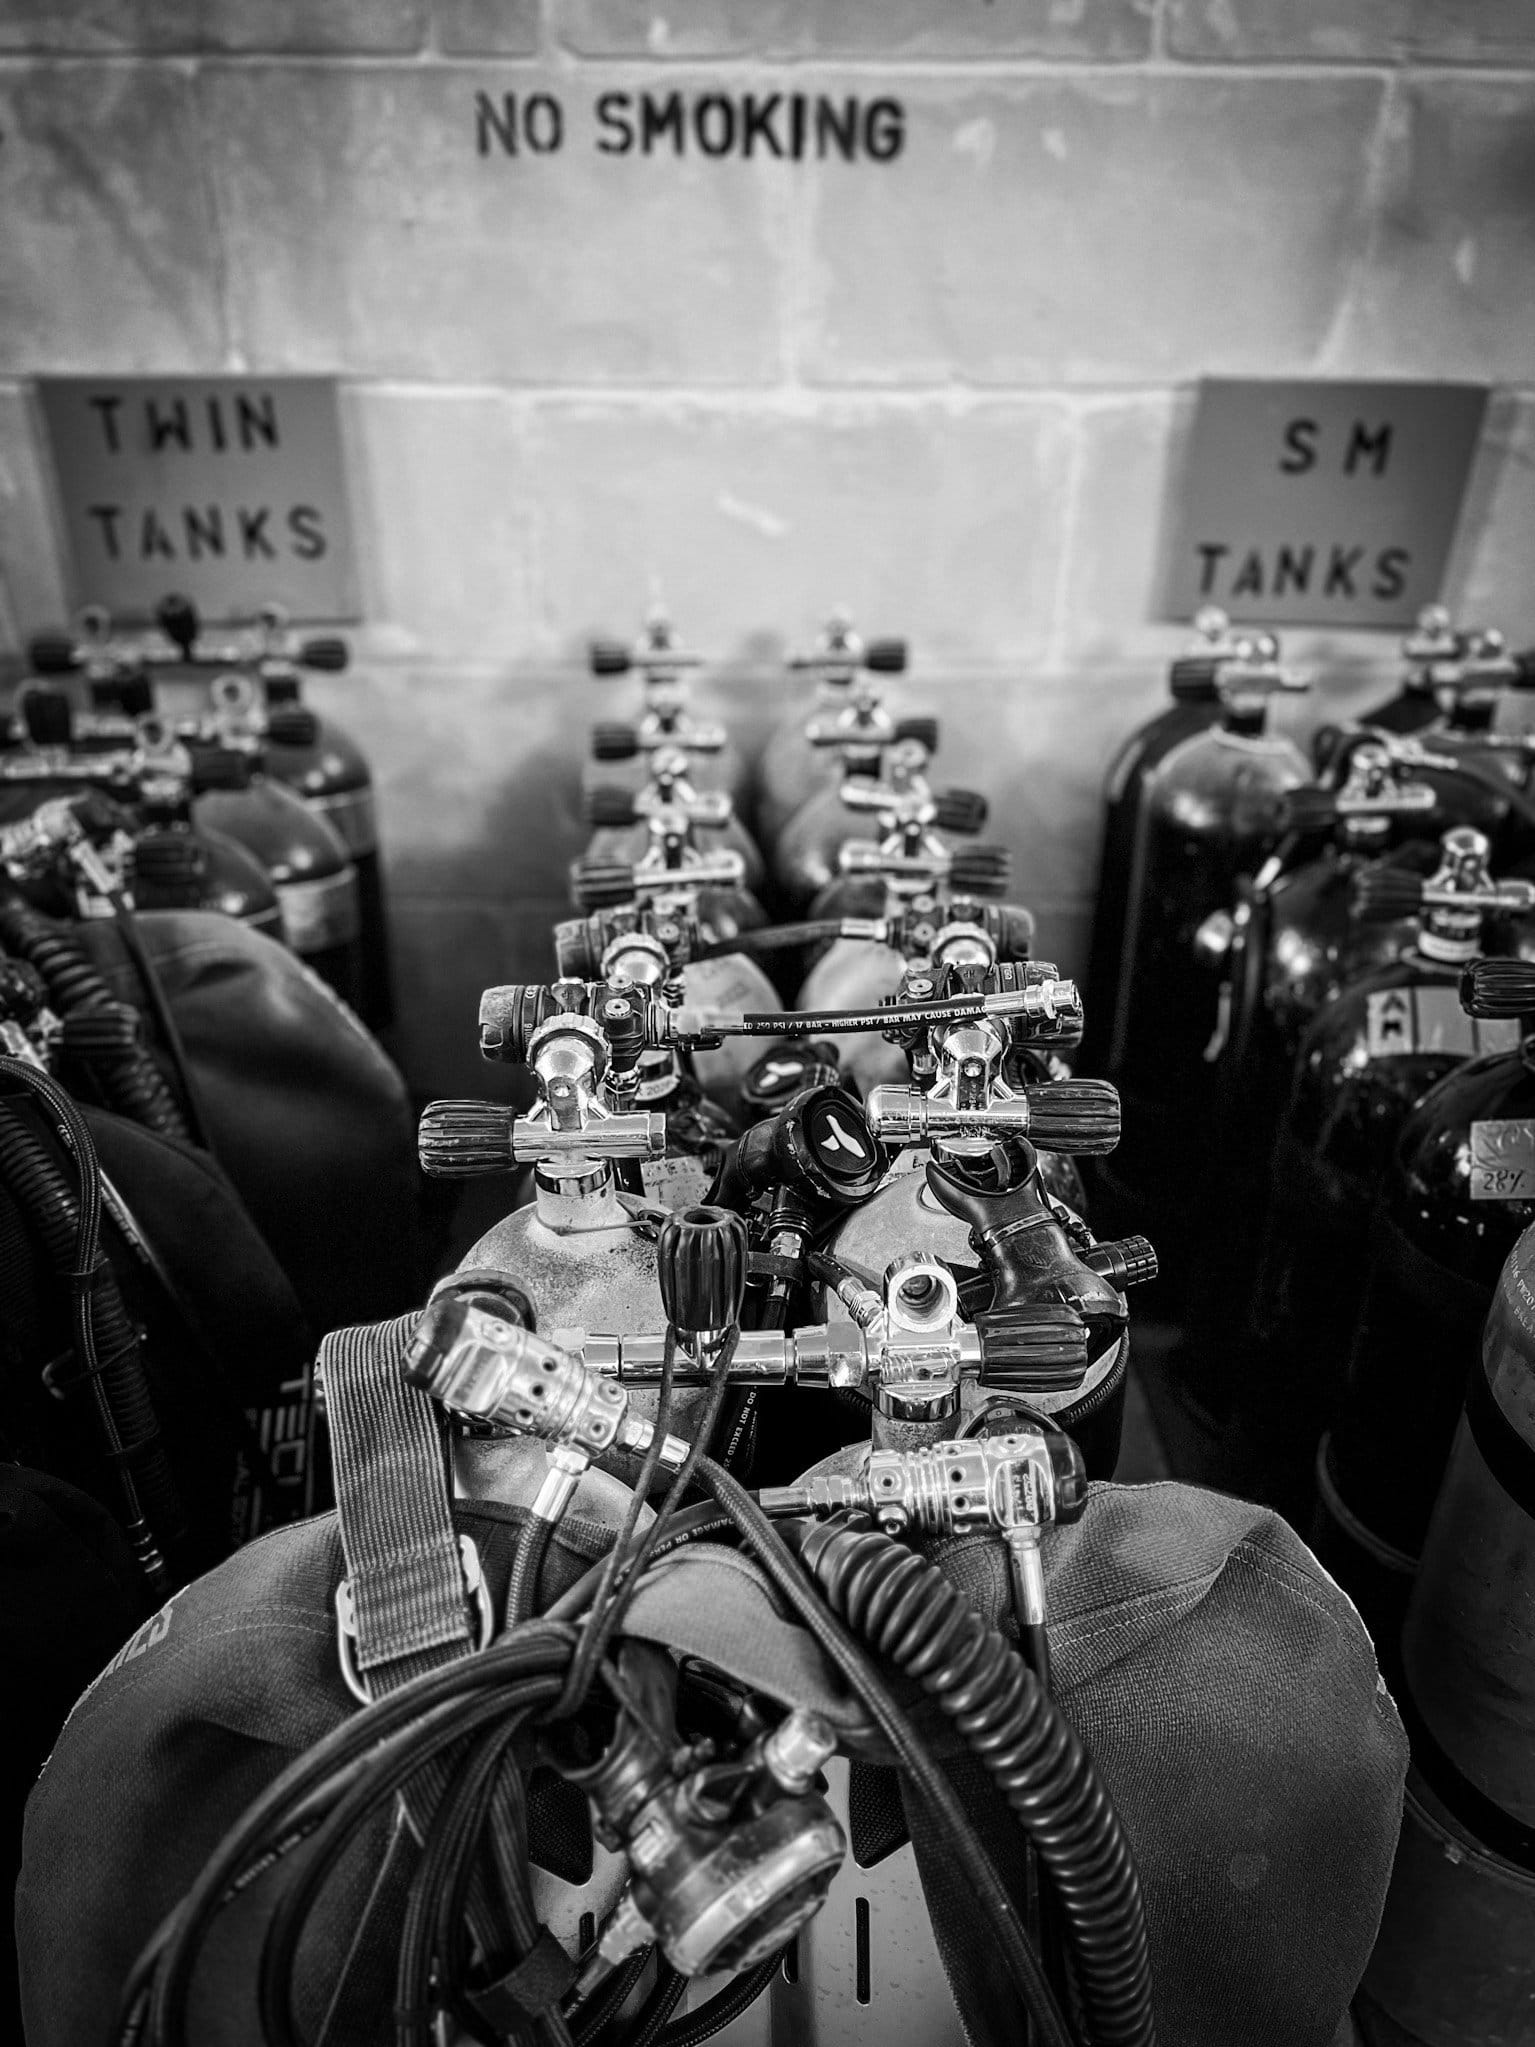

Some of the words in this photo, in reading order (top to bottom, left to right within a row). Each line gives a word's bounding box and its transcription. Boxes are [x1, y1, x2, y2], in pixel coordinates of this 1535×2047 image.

[475, 92, 564, 157] NO
[594, 90, 907, 164] SMOKING
[88, 394, 281, 454] TWIN
[88, 504, 328, 562] TANKS
[1194, 541, 1410, 601] TANKS
[773, 1020, 786, 1030] PSI
[806, 1019, 823, 1029] BAR
[831, 1017, 859, 1028] HIGHER
[860, 1016, 874, 1026] PSI
[883, 1014, 901, 1024] BAR
[902, 1012, 922, 1023] MAY
[924, 1009, 952, 1020] CAUSE
[1482, 1168, 1524, 1194] 28%
[746, 1391, 757, 1405] DO
[739, 1406, 751, 1425] NOT
[727, 1426, 743, 1456] EXCEED
[674, 1532, 689, 1545] OR
